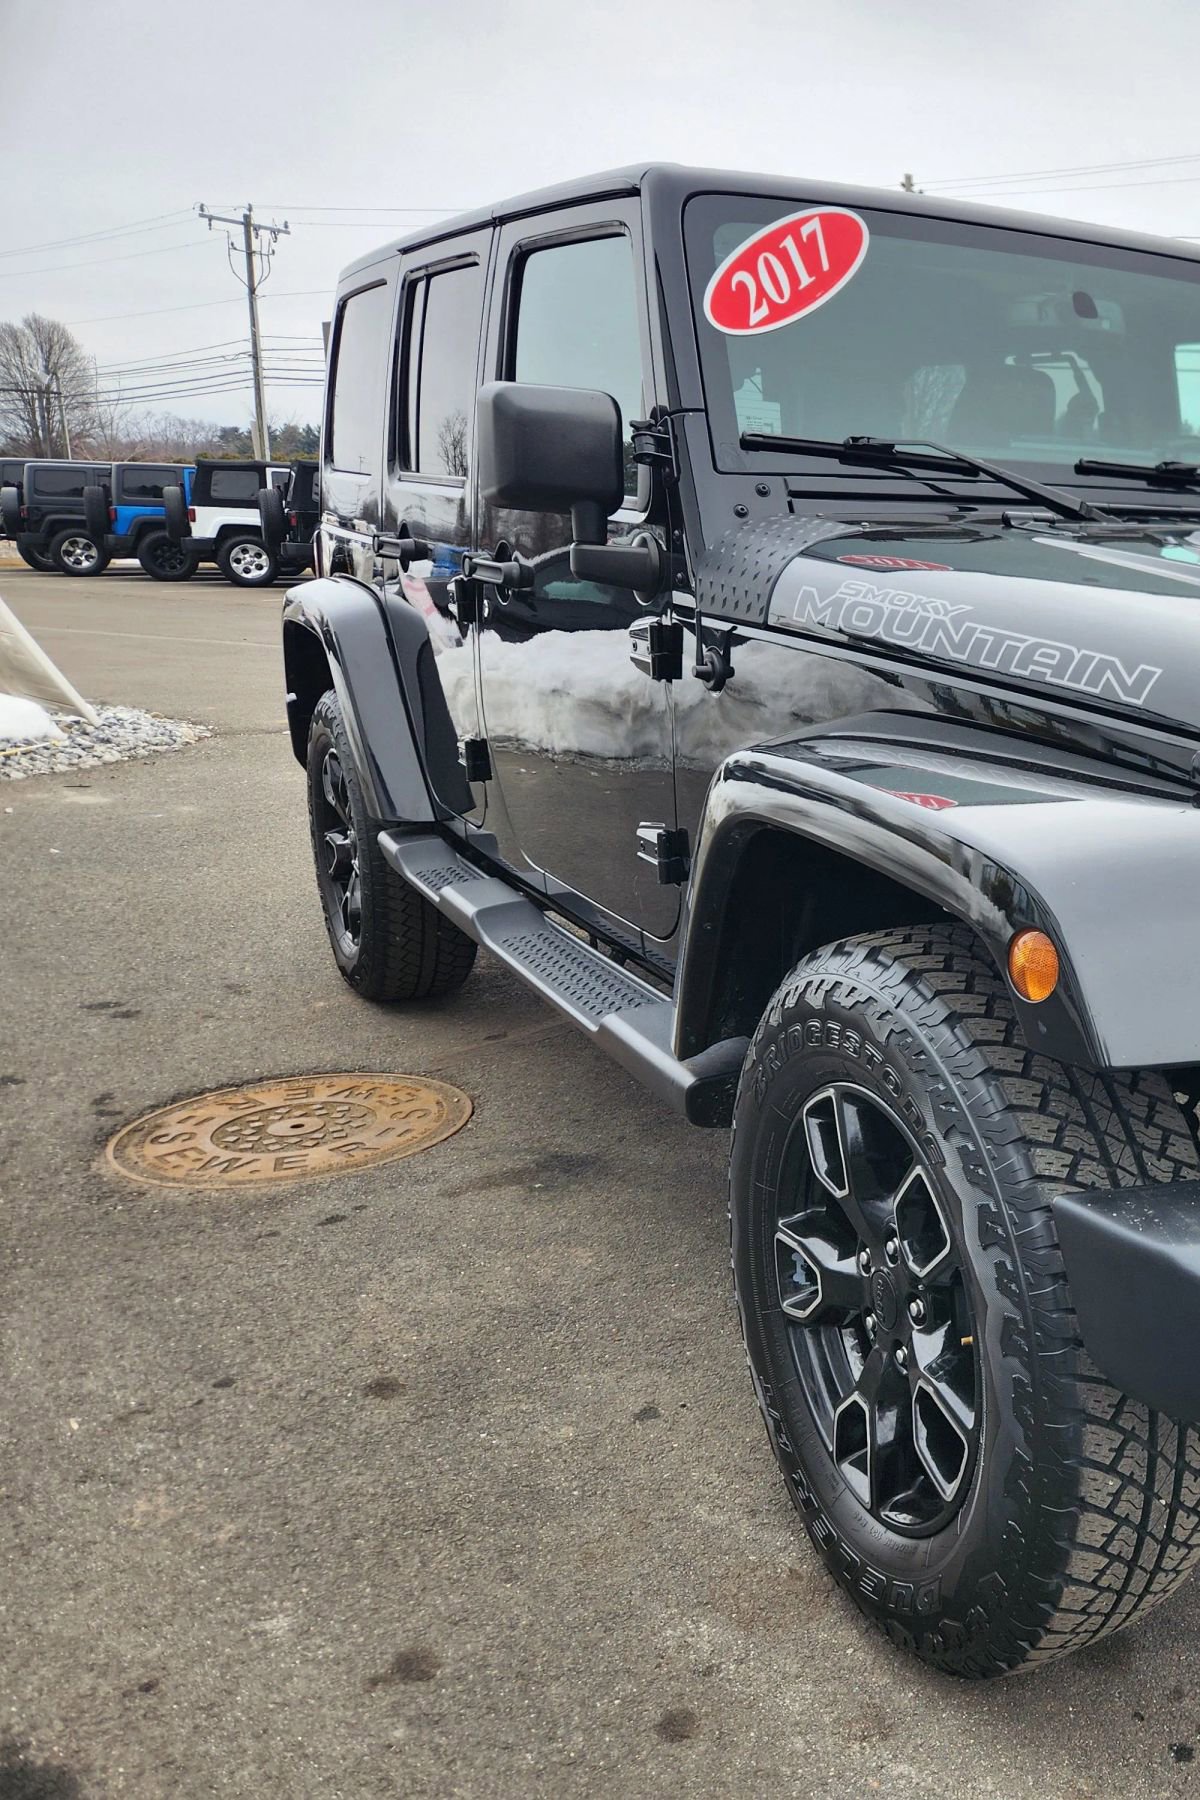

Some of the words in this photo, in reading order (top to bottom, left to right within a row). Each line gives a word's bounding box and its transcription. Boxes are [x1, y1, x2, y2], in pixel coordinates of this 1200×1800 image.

[731, 216, 830, 327] 2017
[836, 580, 975, 619] SMOKY
[793, 586, 1162, 705] MOUNTAIN
[150, 1130, 380, 1175] SEWER
